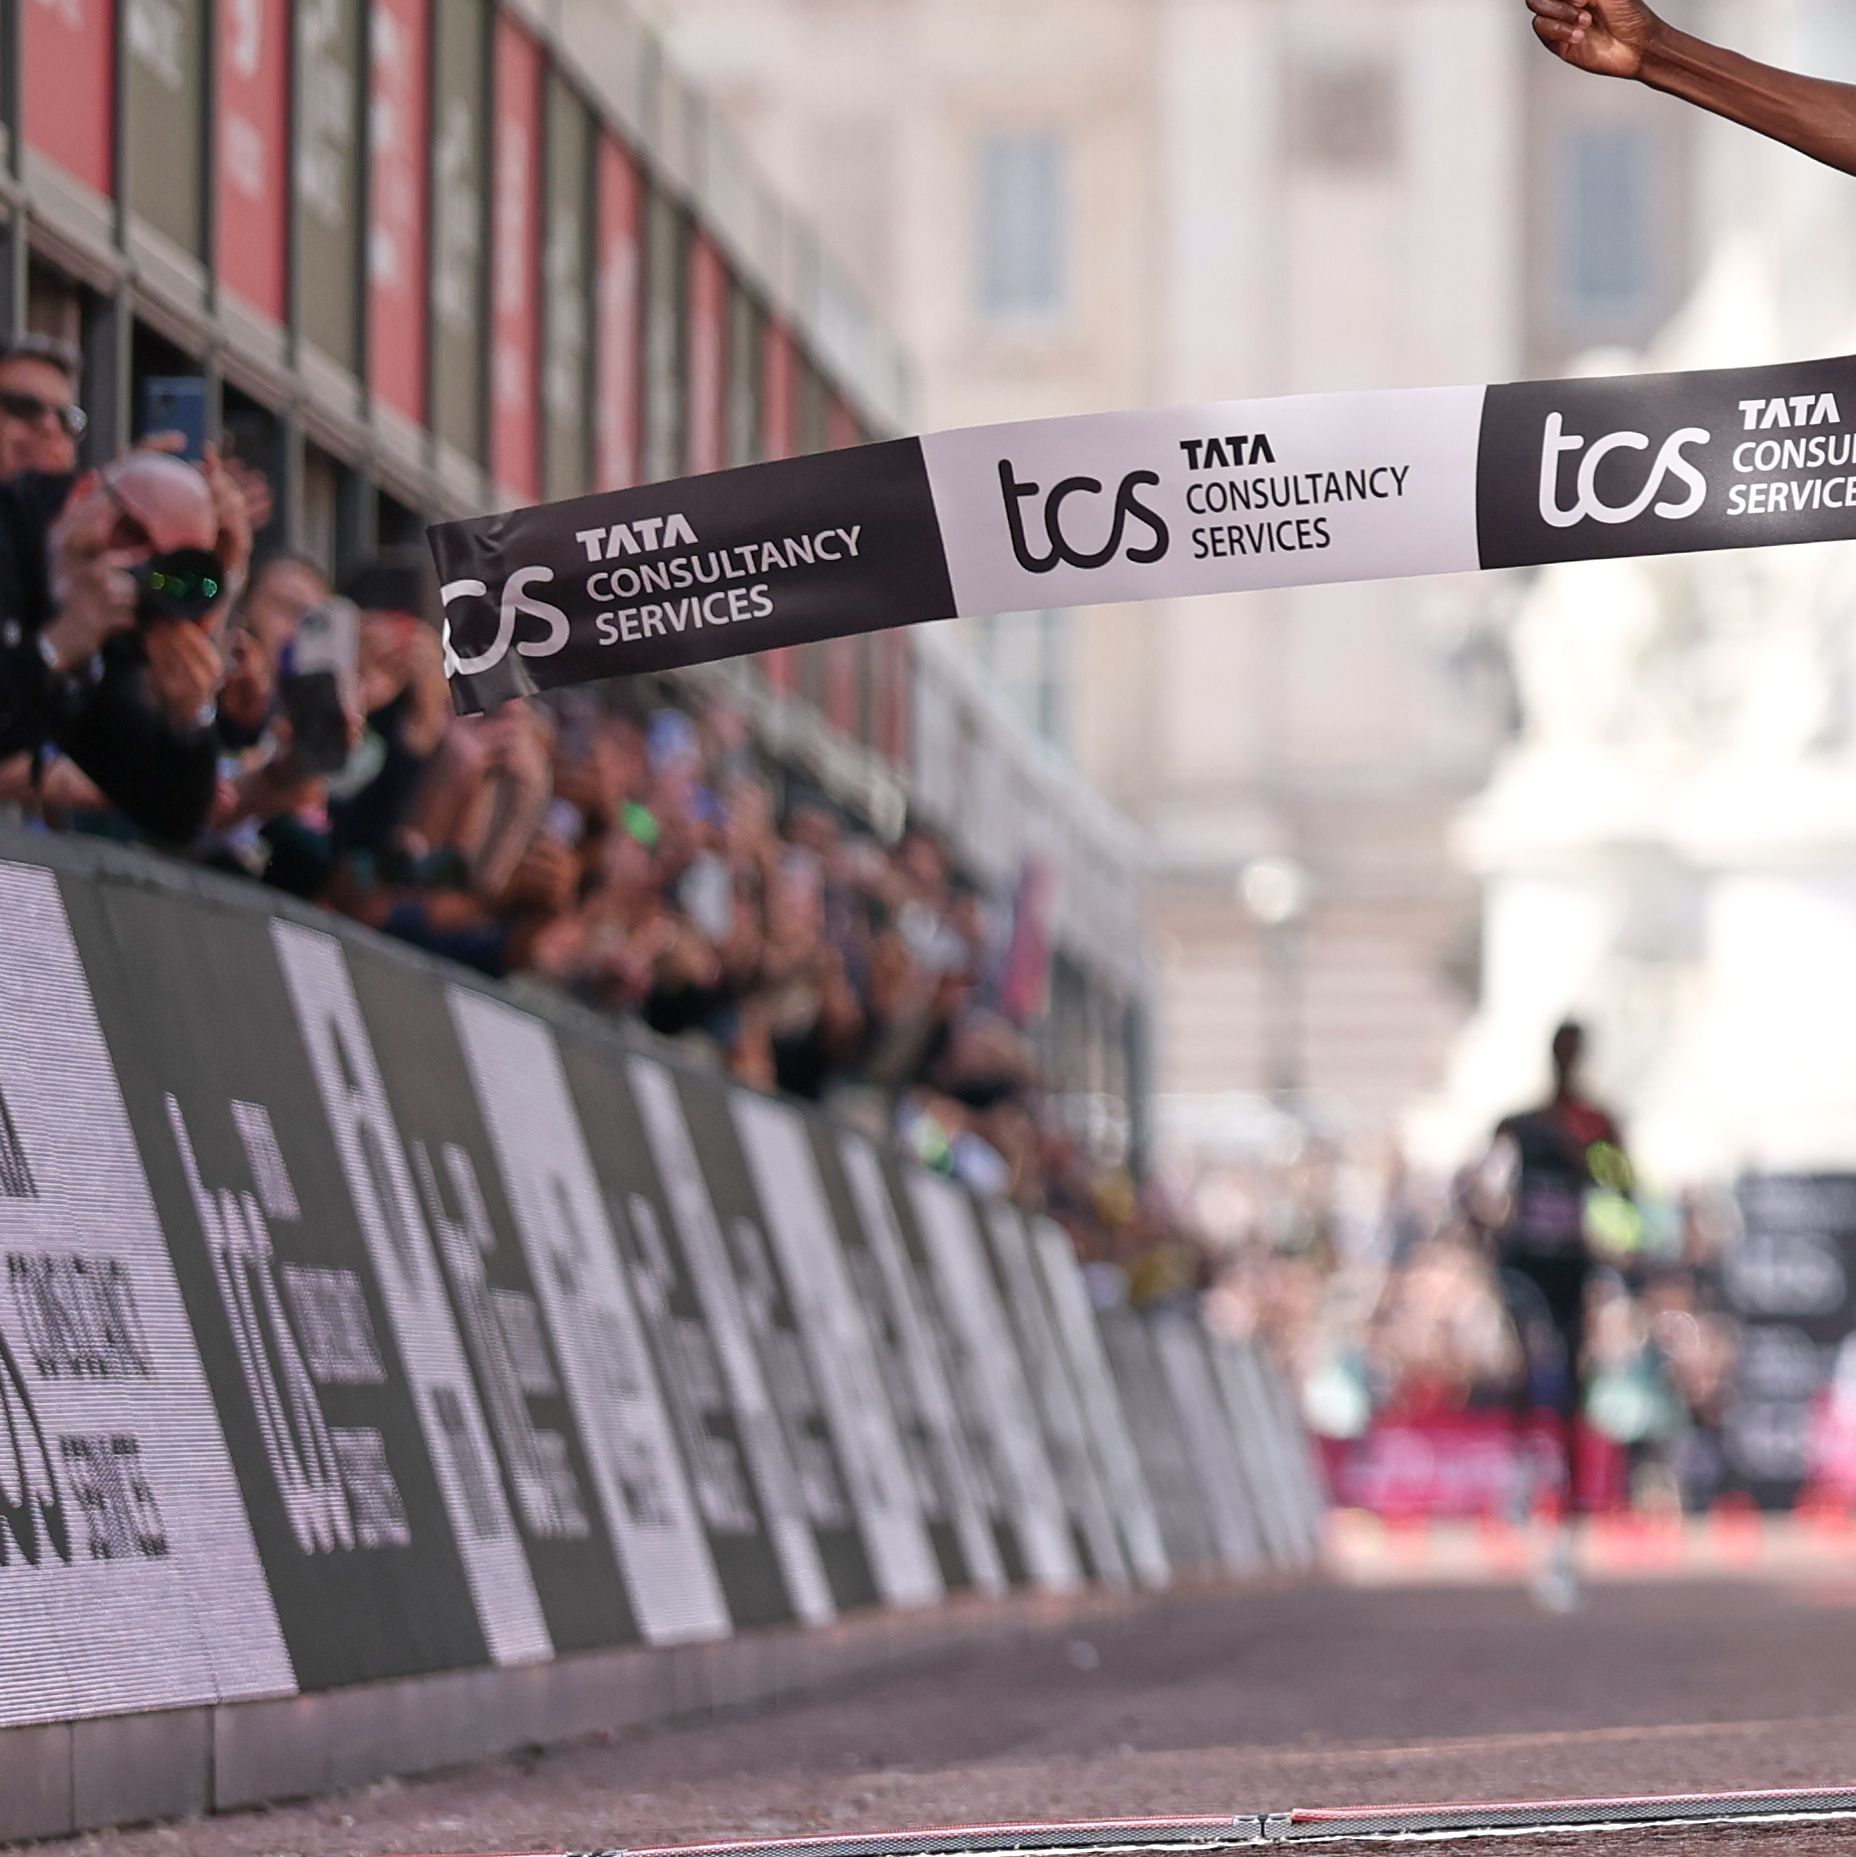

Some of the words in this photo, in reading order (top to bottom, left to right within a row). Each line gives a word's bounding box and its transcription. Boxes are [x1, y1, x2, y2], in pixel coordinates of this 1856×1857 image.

[1737, 392, 1841, 430] TATA
[1181, 433, 1275, 471] TATA
[1538, 411, 1711, 529] tcs
[998, 459, 1170, 575] tcs
[1186, 464, 1410, 515] CONSULTANCY
[576, 513, 698, 563] TATA
[586, 525, 862, 603] CONSULTANCY
[1192, 517, 1331, 560] SERVICES
[442, 565, 570, 676] cs
[595, 584, 773, 647] SERVICES
